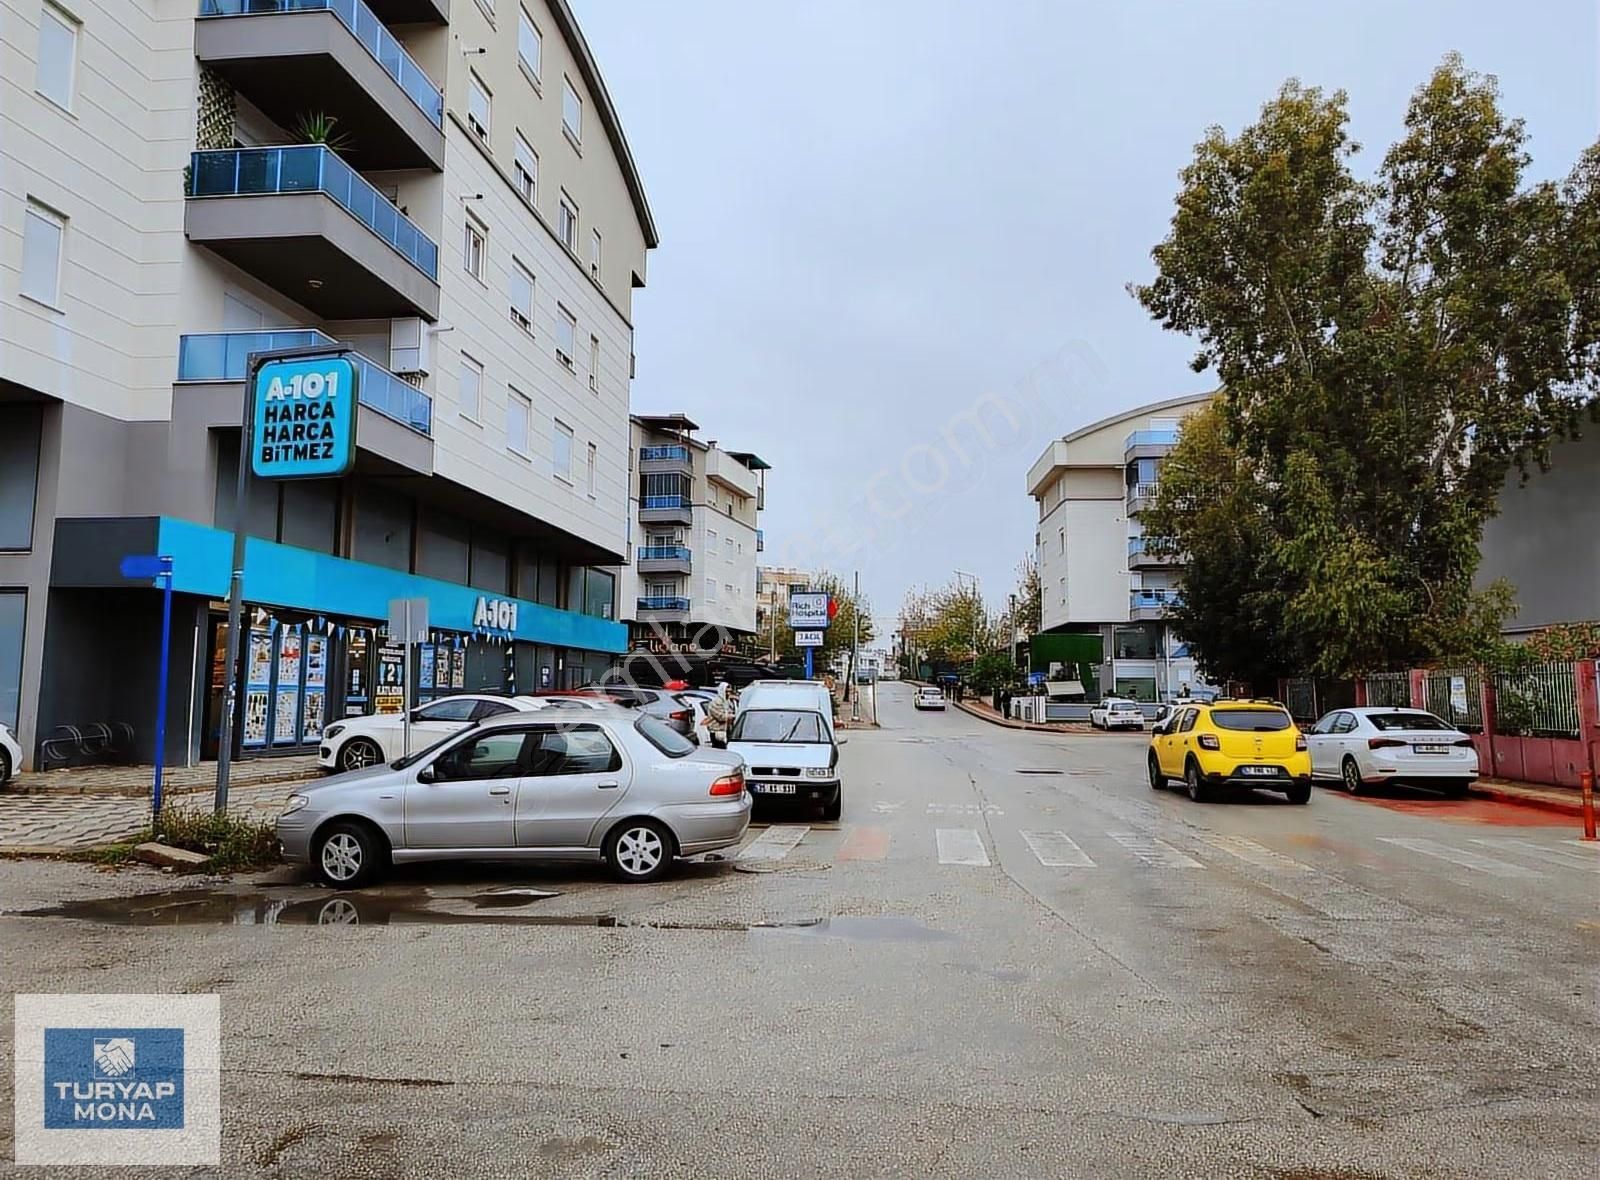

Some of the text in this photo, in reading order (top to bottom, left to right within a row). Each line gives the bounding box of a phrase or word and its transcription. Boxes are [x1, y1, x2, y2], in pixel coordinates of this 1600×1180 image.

[264, 401, 335, 424] HARCA
[263, 421, 334, 443] HARCA
[791, 609, 826, 618] Hospital
